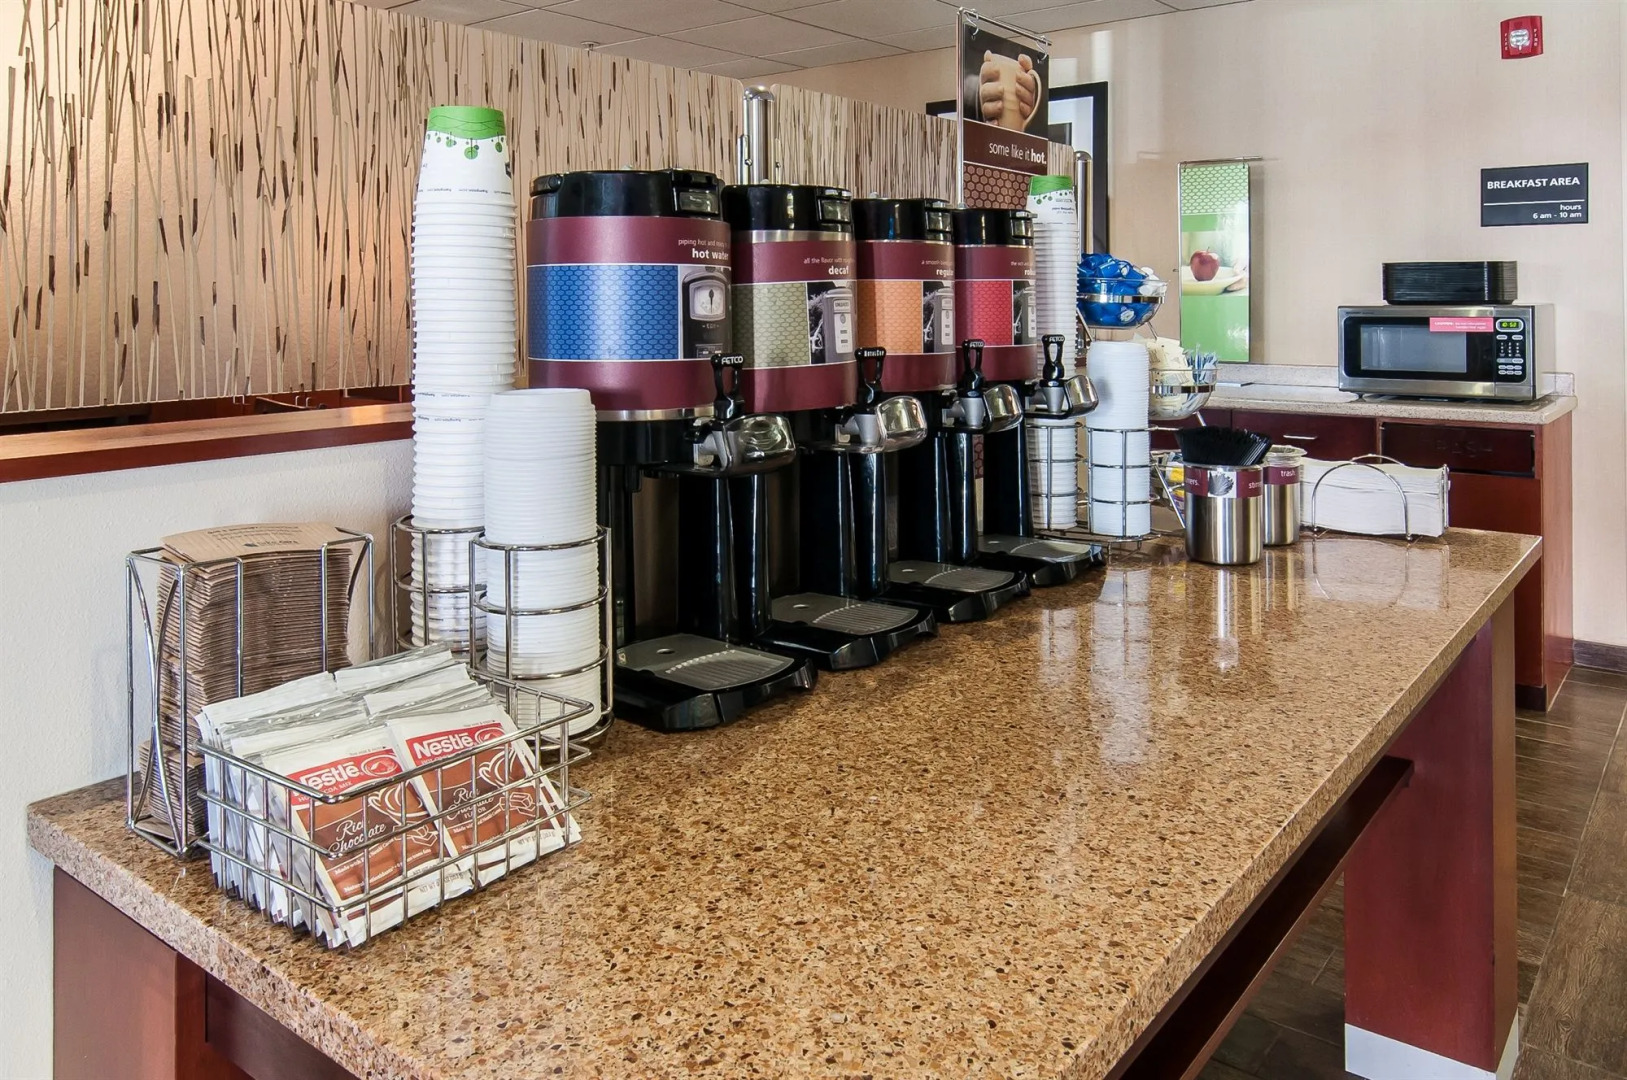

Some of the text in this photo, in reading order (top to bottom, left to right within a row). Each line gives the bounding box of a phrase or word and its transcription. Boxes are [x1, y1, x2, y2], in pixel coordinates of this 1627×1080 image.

[988, 142, 1047, 165] some like it hot.
[1487, 176, 1580, 190] BREAKFAST AREA
[692, 248, 729, 260] hot water
[828, 265, 849, 275] decaf
[722, 356, 744, 365] FETCO
[412, 732, 473, 759] Nestlé
[464, 807, 487, 819] FLAOR
[336, 820, 366, 842] Ric
[328, 823, 387, 855] Chocate
